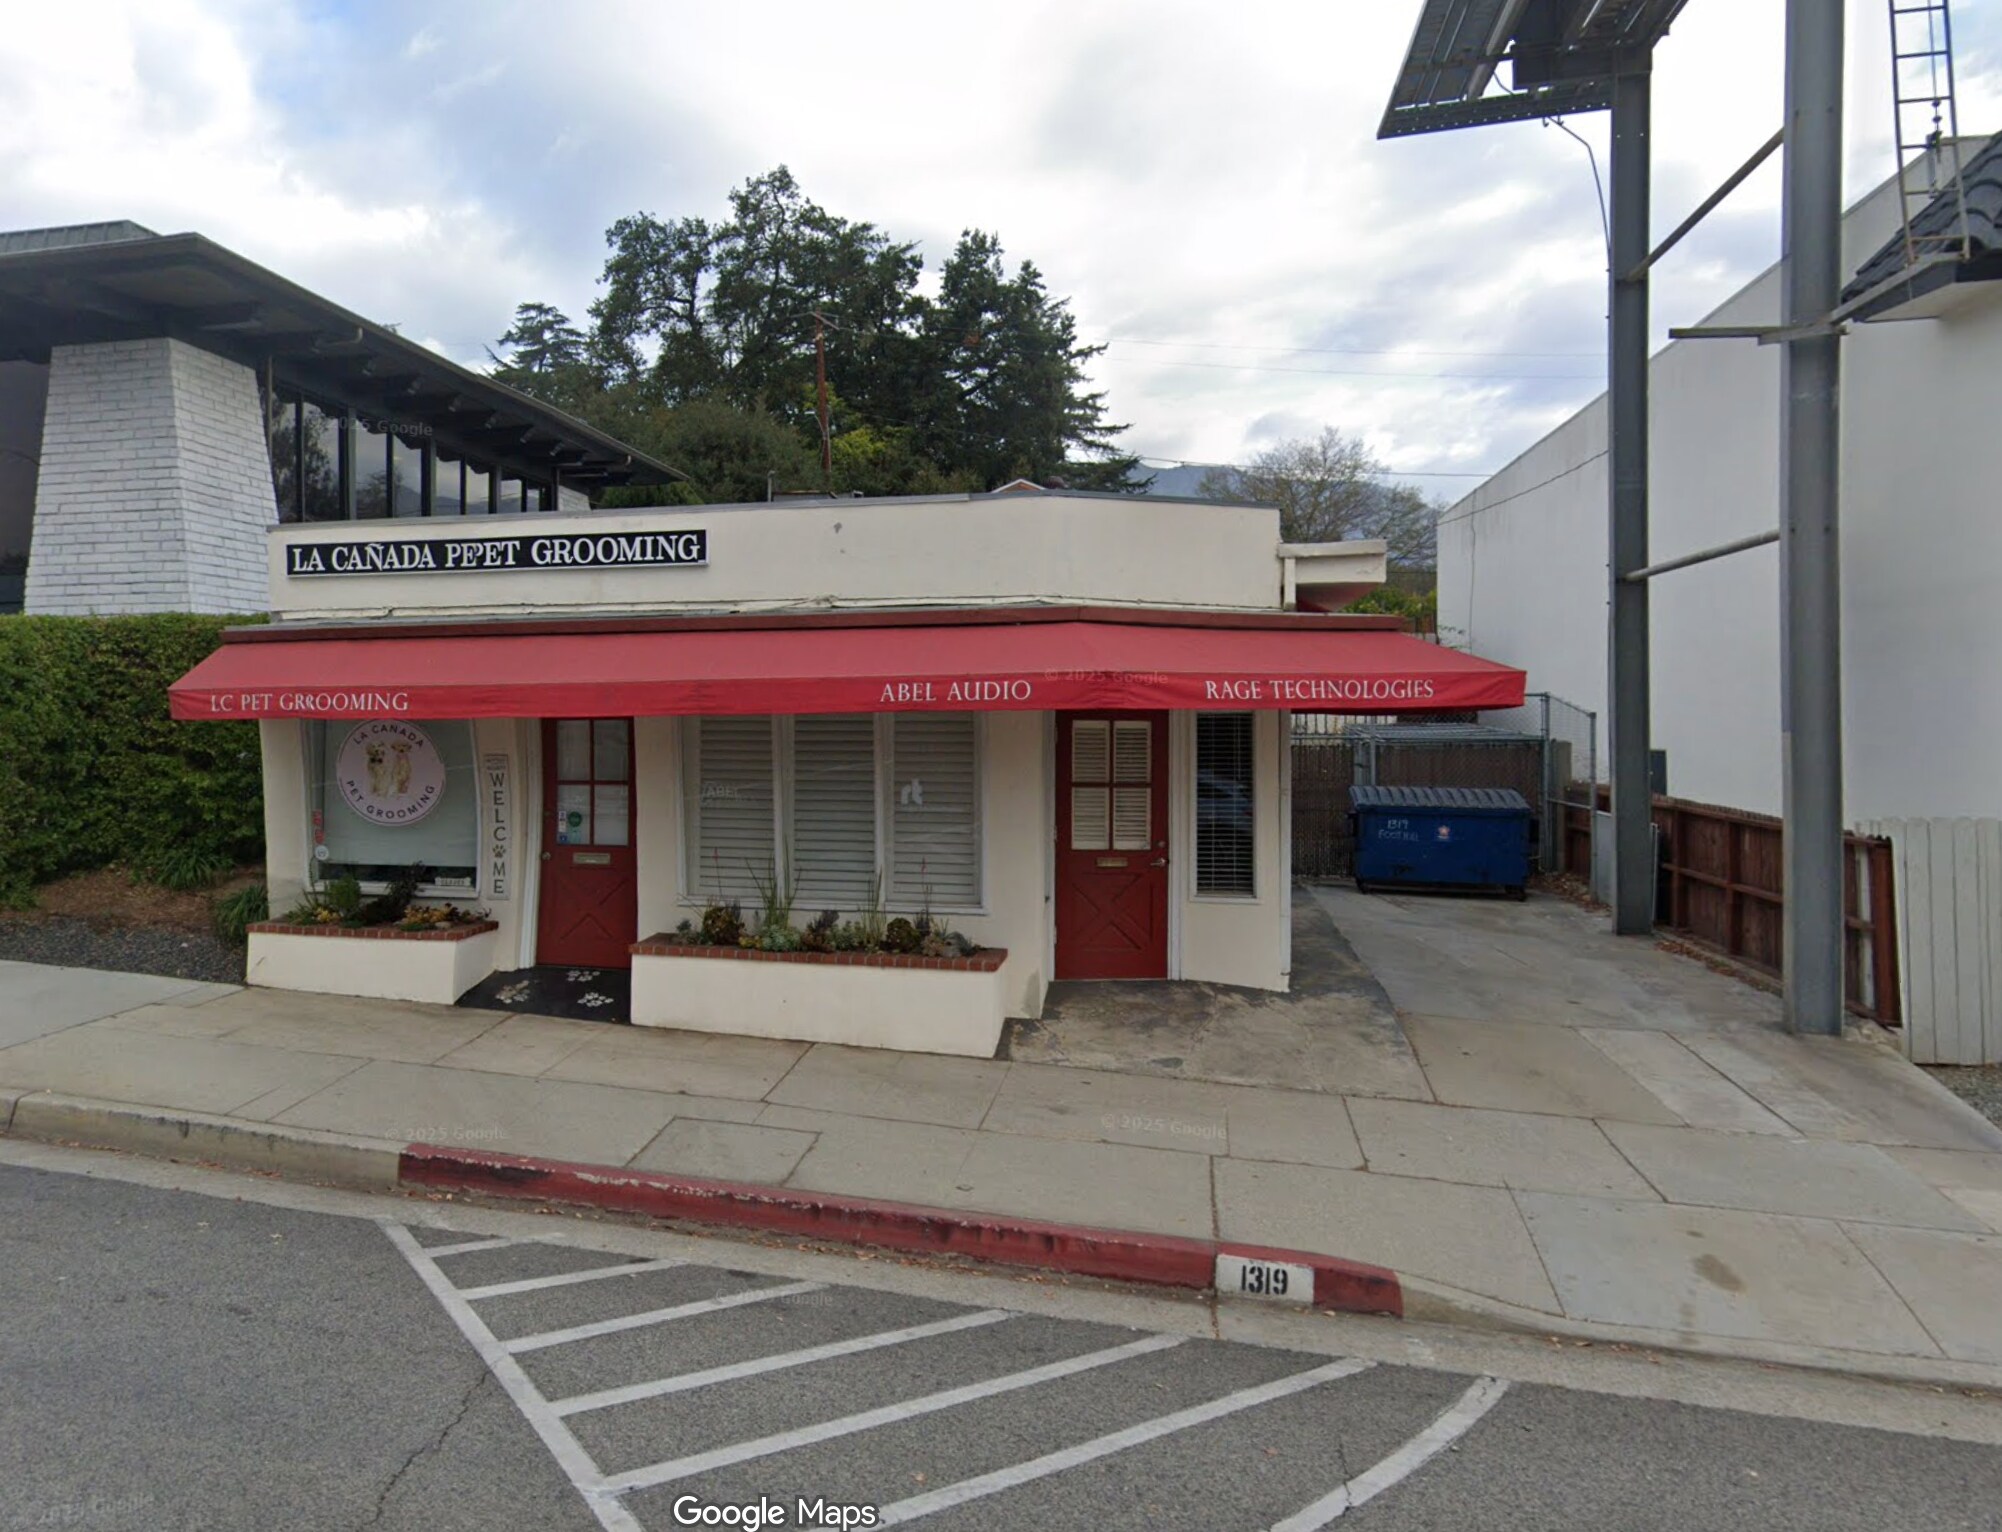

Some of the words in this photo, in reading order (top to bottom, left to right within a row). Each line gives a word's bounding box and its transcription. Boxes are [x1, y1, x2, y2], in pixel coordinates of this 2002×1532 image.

[292, 548, 326, 572] LA
[331, 542, 436, 571] CAÑADA
[531, 534, 700, 565] GROOMING
[211, 694, 233, 712] LC
[241, 693, 273, 711] PET
[880, 682, 936, 702] ABEL
[947, 680, 1031, 701] AUDIO
[1205, 680, 1262, 700] RAGE
[1269, 679, 1434, 699] TECHNOLOGIES
[353, 732, 368, 744] LA
[372, 724, 425, 748] CANADA
[346, 780, 364, 802] PET
[366, 785, 435, 819] GROOMING
[489, 772, 506, 894] WELCME
[1241, 1264, 1288, 1295] 1319
